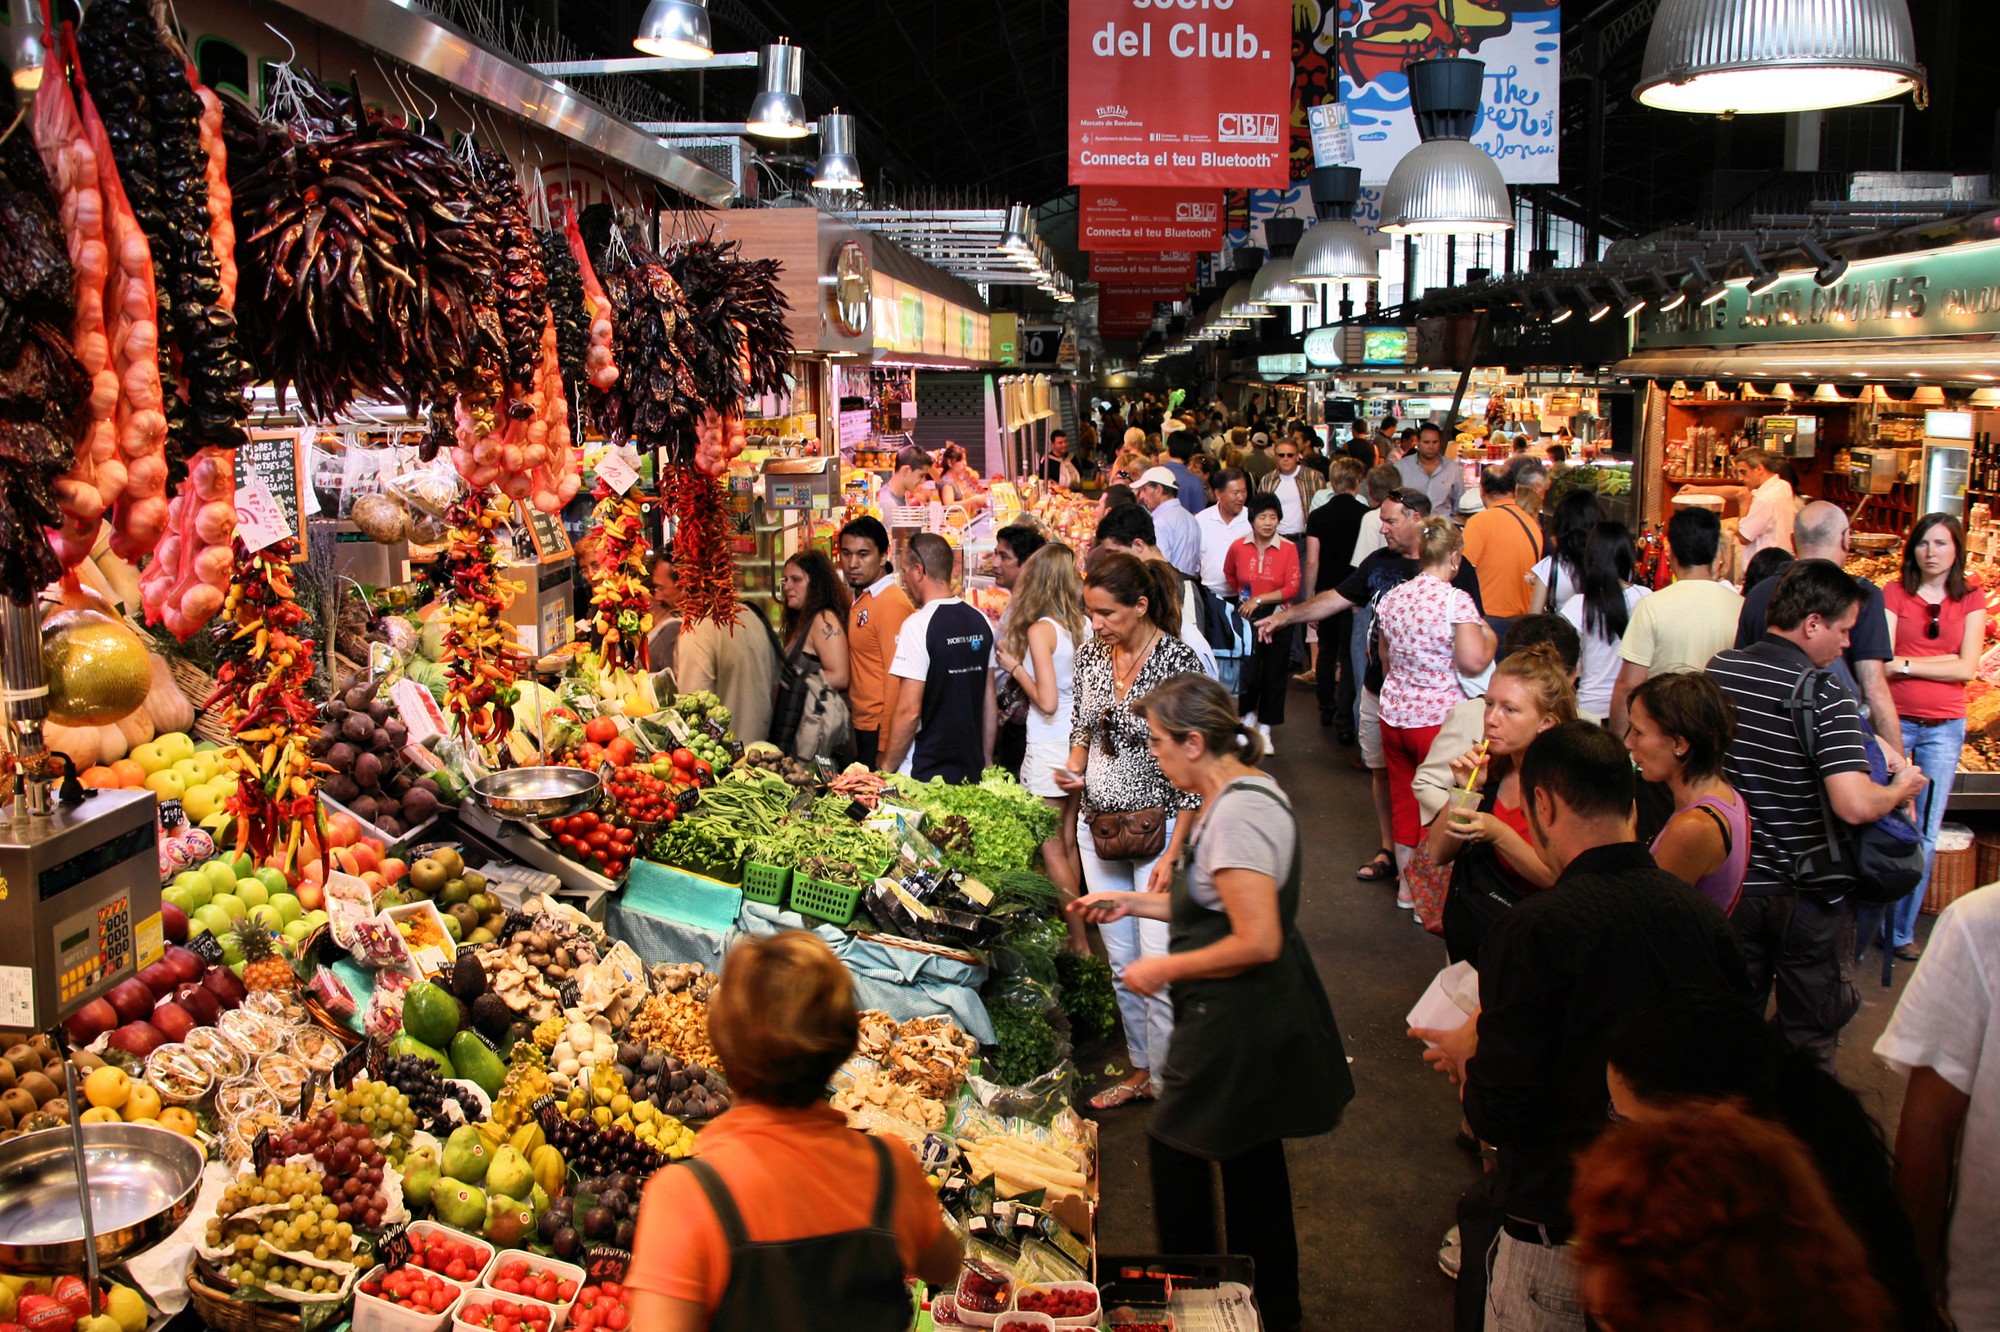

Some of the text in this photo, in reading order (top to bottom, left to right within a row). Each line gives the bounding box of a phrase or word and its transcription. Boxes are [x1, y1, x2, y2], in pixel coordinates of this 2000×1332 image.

[1092, 22, 1270, 60] del Club.
[1483, 65, 1540, 106] The
[1540, 110, 1554, 137] of
[1080, 150, 1150, 166] Connecta
[1154, 151, 1168, 166] el
[1172, 152, 1196, 166] teu
[1086, 226, 1131, 237] Connecta
[1133, 227, 1143, 237] el
[1146, 228, 1162, 237] teu
[1094, 265, 1128, 273] Connecta
[1129, 265, 1137, 273] el
[1138, 266, 1150, 274] teu
